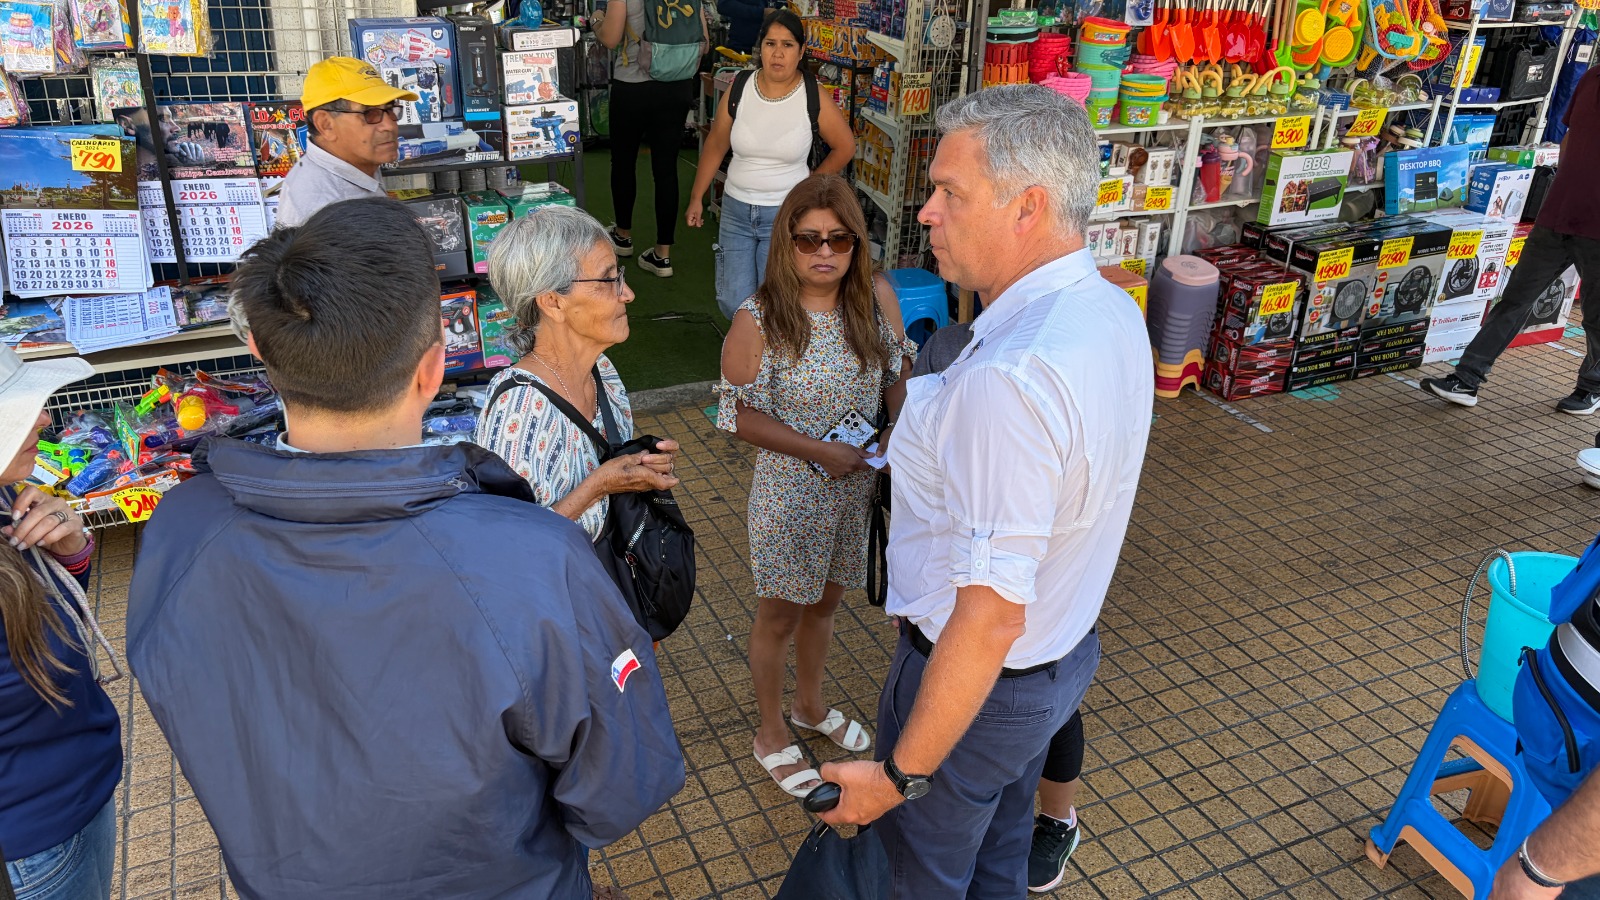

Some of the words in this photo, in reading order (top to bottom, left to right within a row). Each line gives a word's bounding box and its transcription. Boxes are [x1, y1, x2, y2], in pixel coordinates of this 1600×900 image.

[536, 52, 555, 60] TOYS
[465, 151, 500, 162] SHOTGUN
[1303, 156, 1331, 172] BBQ
[1400, 161, 1428, 170] DESKTOP
[1428, 160, 1442, 168] BBQ
[180, 192, 218, 200] 2026
[52, 222, 94, 230] 2026
[190, 228, 200, 236] 15
[204, 228, 214, 236] 16
[61, 238, 66, 246] 1
[76, 238, 81, 246] 2
[91, 238, 96, 246] 3
[105, 238, 111, 246] 4
[192, 238, 204, 246] 22
[232, 236, 242, 244] 25
[16, 249, 22, 257] 5
[31, 249, 36, 257] 6
[47, 249, 52, 257] 7
[62, 249, 68, 257] 8
[76, 249, 82, 257] 9
[89, 249, 100, 257] 10
[104, 249, 114, 257] 11
[221, 246, 230, 254] 31
[15, 260, 25, 268] 12
[29, 260, 40, 268] 13
[45, 260, 55, 268] 14
[60, 260, 70, 268] 15
[76, 260, 86, 268] 16
[91, 260, 100, 268] 17
[106, 260, 116, 268] 18
[16, 270, 26, 278] 19
[30, 270, 42, 278] 20
[46, 270, 56, 278] 21
[60, 270, 72, 278] 22
[76, 270, 88, 278] 23
[91, 270, 102, 278] 24
[106, 270, 116, 278] 25
